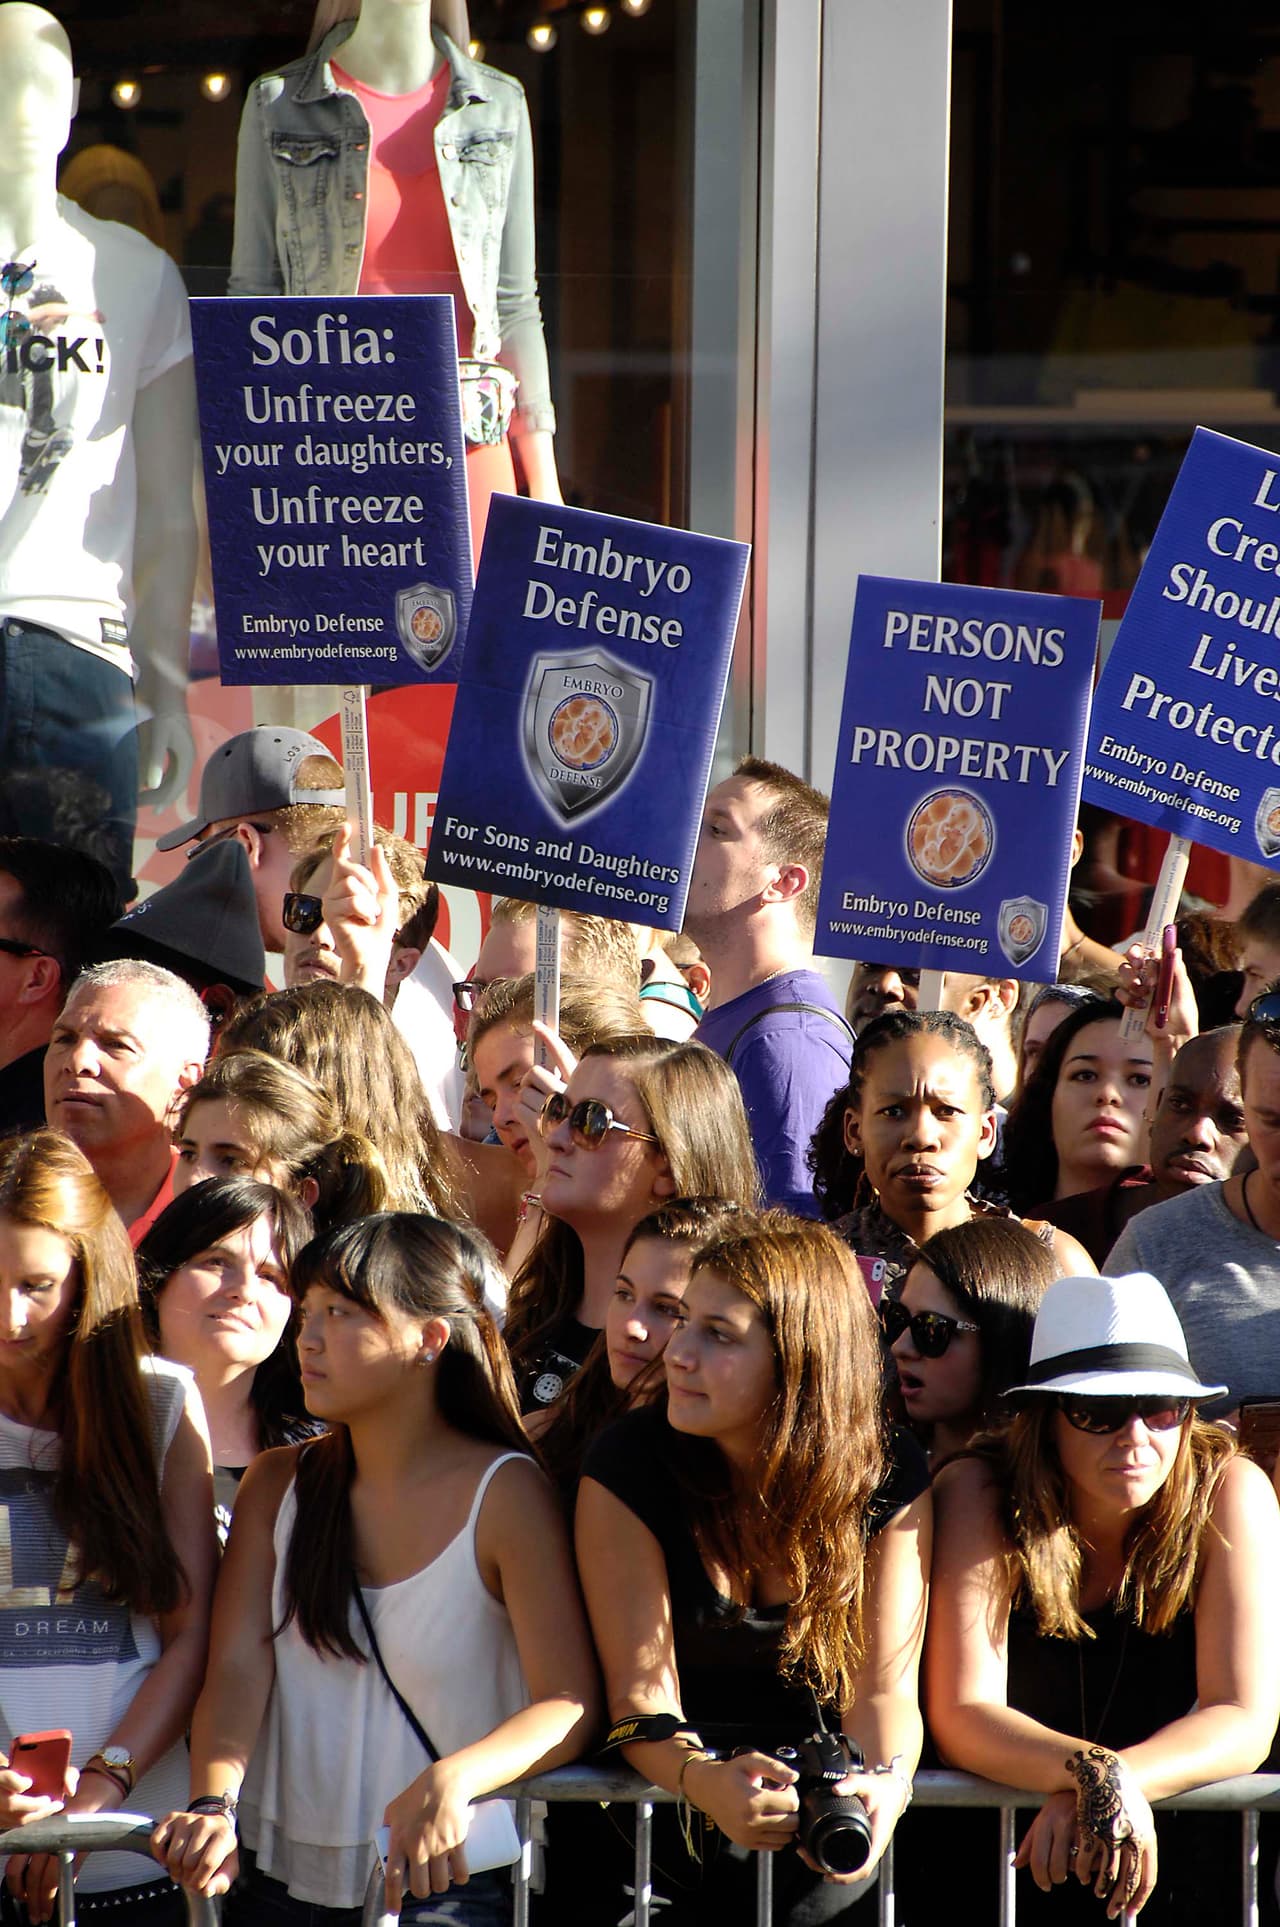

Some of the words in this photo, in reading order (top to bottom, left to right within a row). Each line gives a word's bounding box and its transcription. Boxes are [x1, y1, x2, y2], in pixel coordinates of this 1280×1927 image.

[250, 313, 395, 366] Sofia:
[243, 384, 416, 423] Unfreeze
[215, 444, 284, 475] your
[295, 434, 453, 473] daughters,
[251, 485, 424, 524] Unfreeze
[1252, 469, 1280, 516] L
[257, 544, 330, 576] your
[341, 535, 427, 567] heart
[532, 525, 692, 597] Embryo
[1207, 517, 1280, 577] Cre
[522, 579, 684, 648] Defense
[1162, 563, 1280, 640] Shoul
[242, 613, 310, 637] Embryo
[315, 613, 384, 633] Defense
[882, 611, 1065, 668] PERSONS
[235, 643, 397, 662] www.embryodefense.org
[1189, 633, 1280, 700] Live
[562, 675, 624, 699] EMBRYO
[922, 674, 1012, 720] NOT
[549, 768, 602, 788] DEFENSE
[850, 726, 1070, 788] PROPERTY
[1099, 735, 1168, 775] Embryo
[1170, 762, 1241, 802] Defense
[444, 817, 480, 843] For
[483, 825, 529, 853] Sons
[535, 841, 573, 863] and
[578, 845, 681, 885] Daughters
[441, 856, 670, 914] www.embryodefense.org
[842, 892, 909, 918] Embryo
[912, 900, 982, 926] Defense
[829, 919, 989, 954] www.embryodefense.org
[15, 1619, 109, 1637] DREAM
